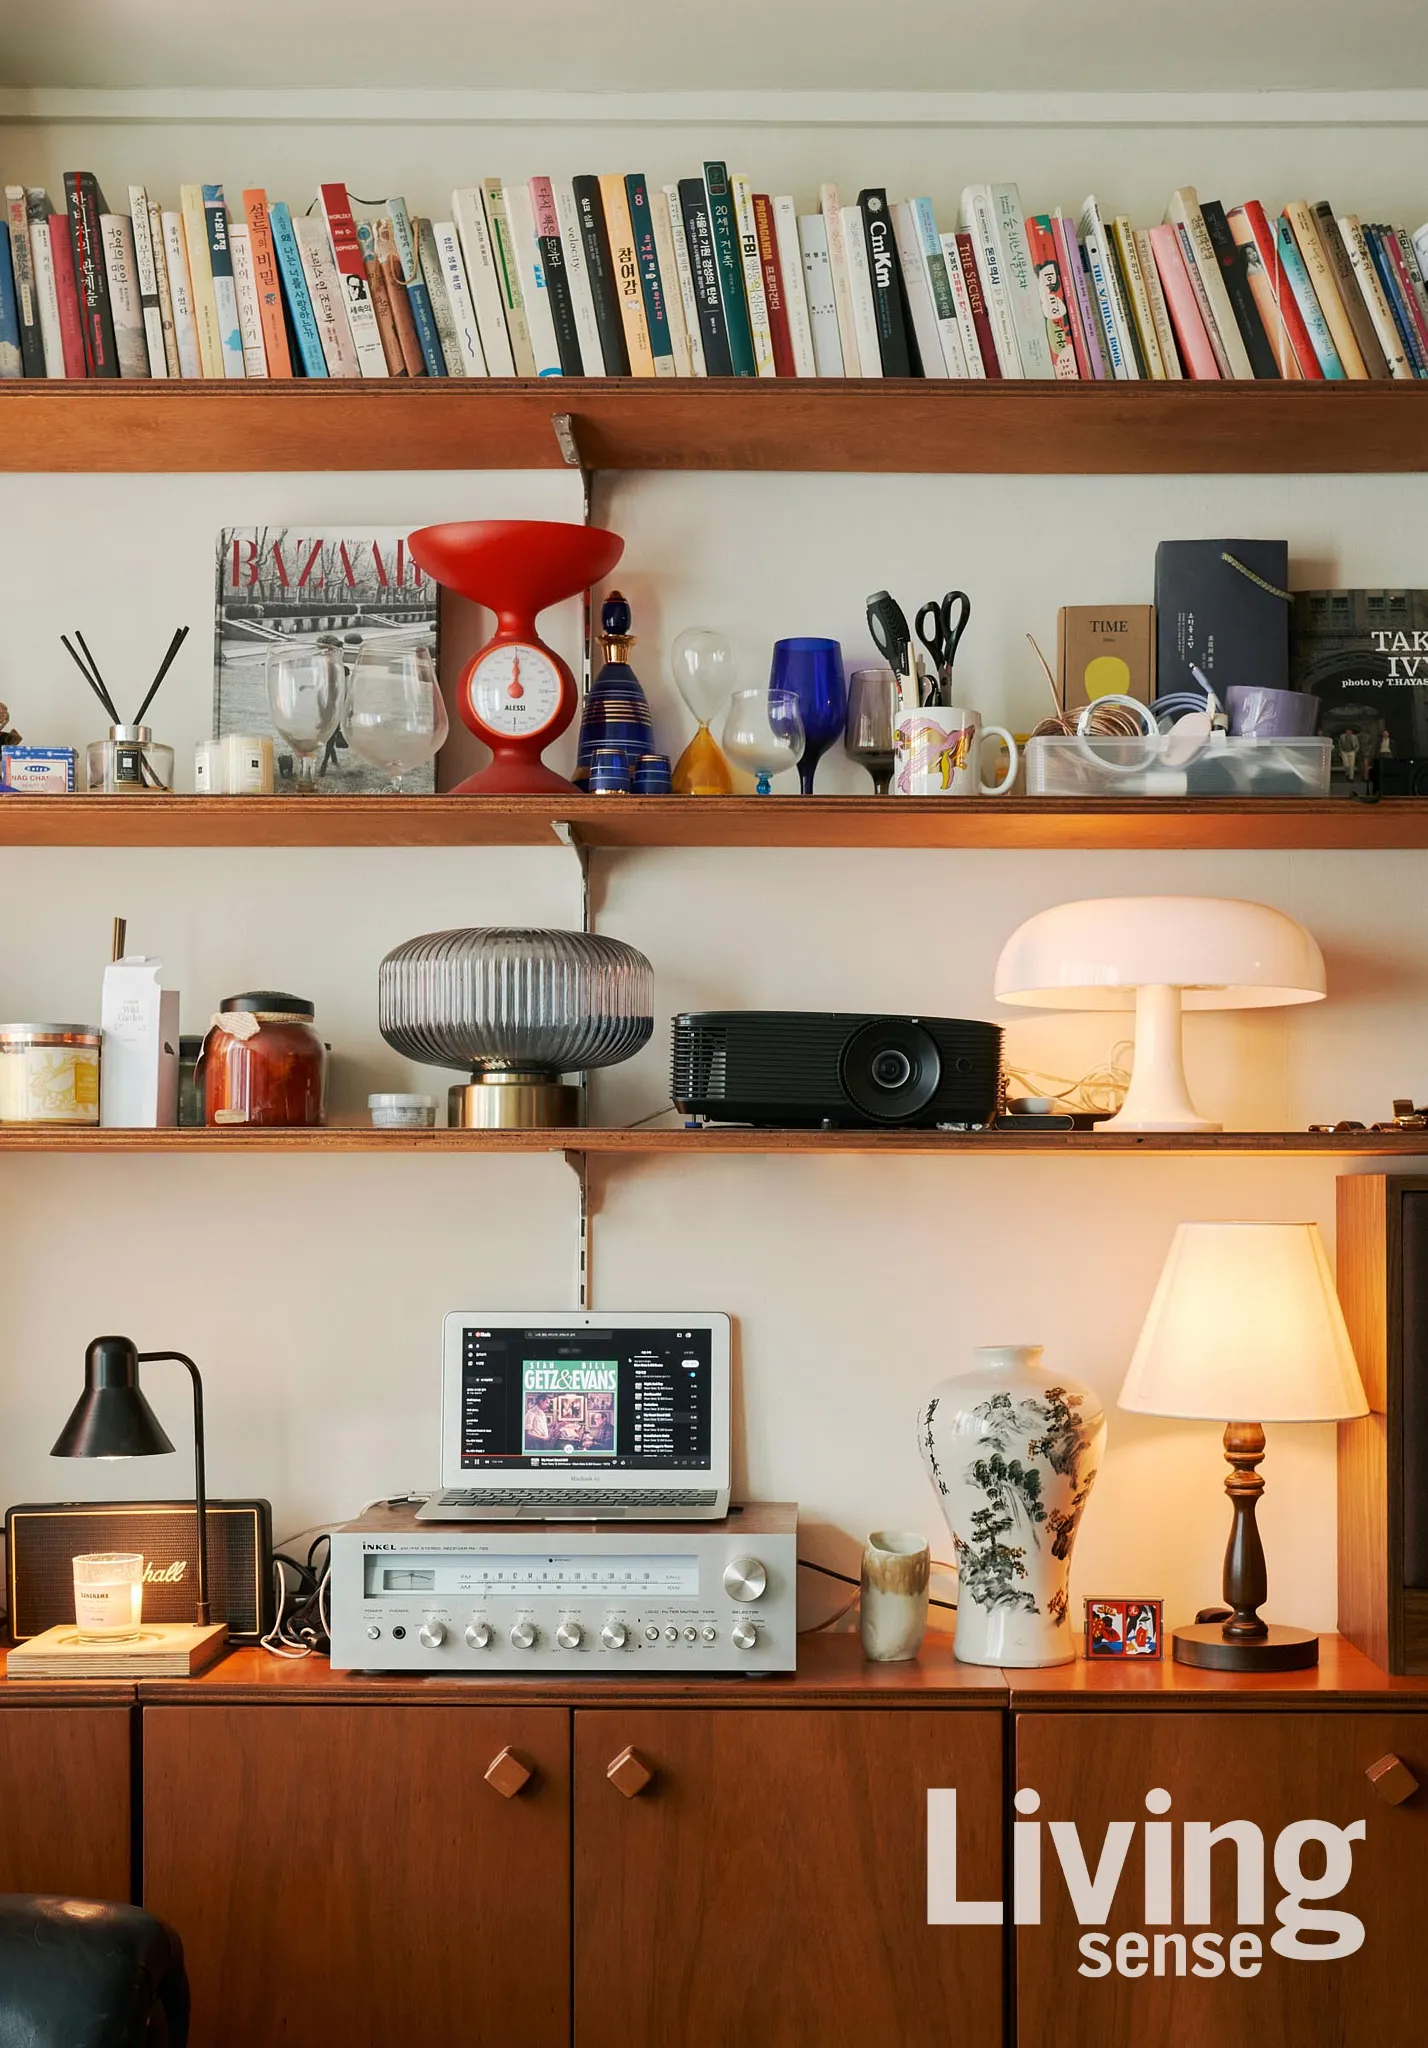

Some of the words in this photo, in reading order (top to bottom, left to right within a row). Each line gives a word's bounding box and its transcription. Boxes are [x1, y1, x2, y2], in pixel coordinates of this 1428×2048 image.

[581, 198, 592, 212] 싱크
[250, 203, 268, 249] 설득의
[540, 213, 556, 235] 책은
[696, 211, 709, 238] 서울의
[756, 199, 773, 261] PROPAGANDA
[108, 227, 124, 260] 우연의
[546, 237, 562, 268] 도끼다
[700, 240, 710, 258] 기원
[720, 239, 734, 269] 건축
[742, 234, 757, 258] FBI
[870, 220, 892, 288] CmKm
[959, 242, 975, 269] THE
[111, 263, 128, 284] 음악
[257, 252, 276, 286] 비밀
[617, 247, 638, 296] 참여감
[702, 259, 716, 285] 경성의
[747, 258, 761, 290] 행동의
[1009, 251, 1029, 292] 식물학자
[707, 286, 719, 305] 탄생
[766, 265, 781, 310] 프로파간다
[965, 271, 984, 316] SECRET
[320, 294, 335, 325] 조르바
[350, 304, 372, 315] 세속의
[750, 290, 767, 329] 심리학
[1093, 264, 1104, 285] THE
[1108, 336, 1122, 368] BOOK
[231, 538, 422, 588] BAZAAR
[1089, 620, 1128, 633] TIME
[1371, 631, 1428, 652] TAK
[1388, 656, 1428, 677] IV
[1341, 679, 1370, 688] photo
[1372, 679, 1384, 688] by
[504, 704, 526, 712] ALESSI
[117, 1014, 144, 1022] Garden
[123, 1005, 139, 1014] Wild
[362, 1541, 397, 1551] INKEL
[142, 1561, 187, 1583] hall
